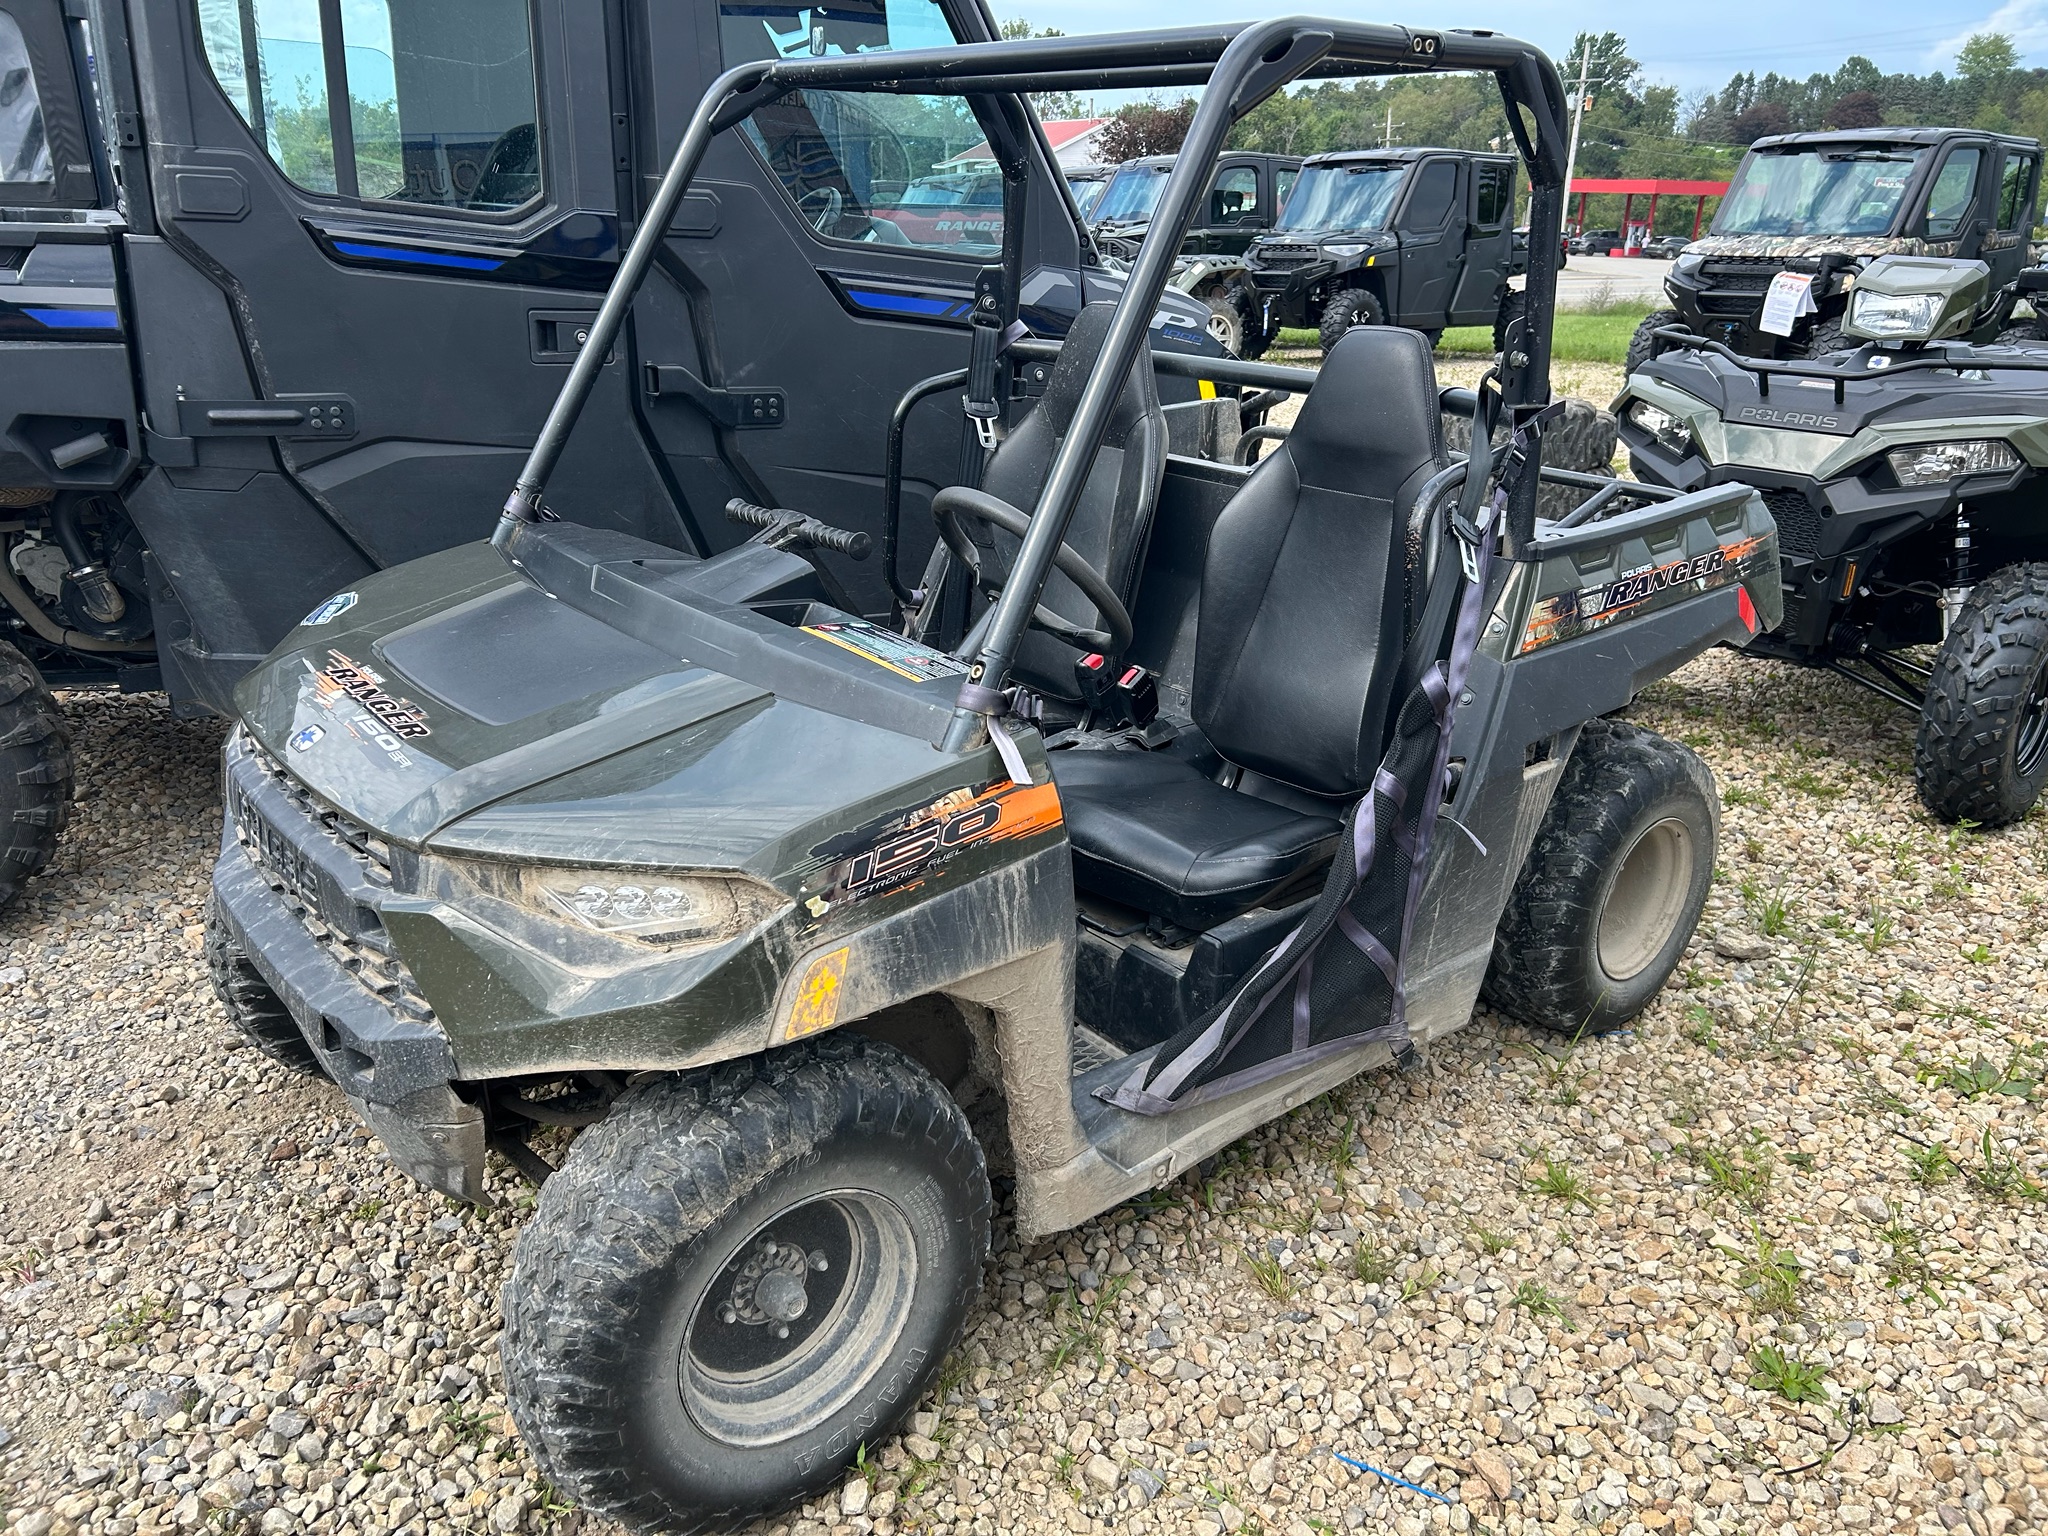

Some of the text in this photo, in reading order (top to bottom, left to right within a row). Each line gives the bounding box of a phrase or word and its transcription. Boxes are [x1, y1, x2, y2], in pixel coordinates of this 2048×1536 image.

[935, 221, 1004, 231] RANGE
[1163, 328, 1204, 343] 1000
[1739, 407, 1839, 428] POLARIS
[1606, 549, 1726, 608] RANGER
[1621, 563, 1653, 579] POLARIS
[327, 667, 431, 740] RANGER
[352, 714, 402, 751] 150
[827, 816, 1036, 907] ELECTRONIC FUEL INJECTION
[847, 801, 1002, 889] 150
[794, 1347, 928, 1476] WANDA
